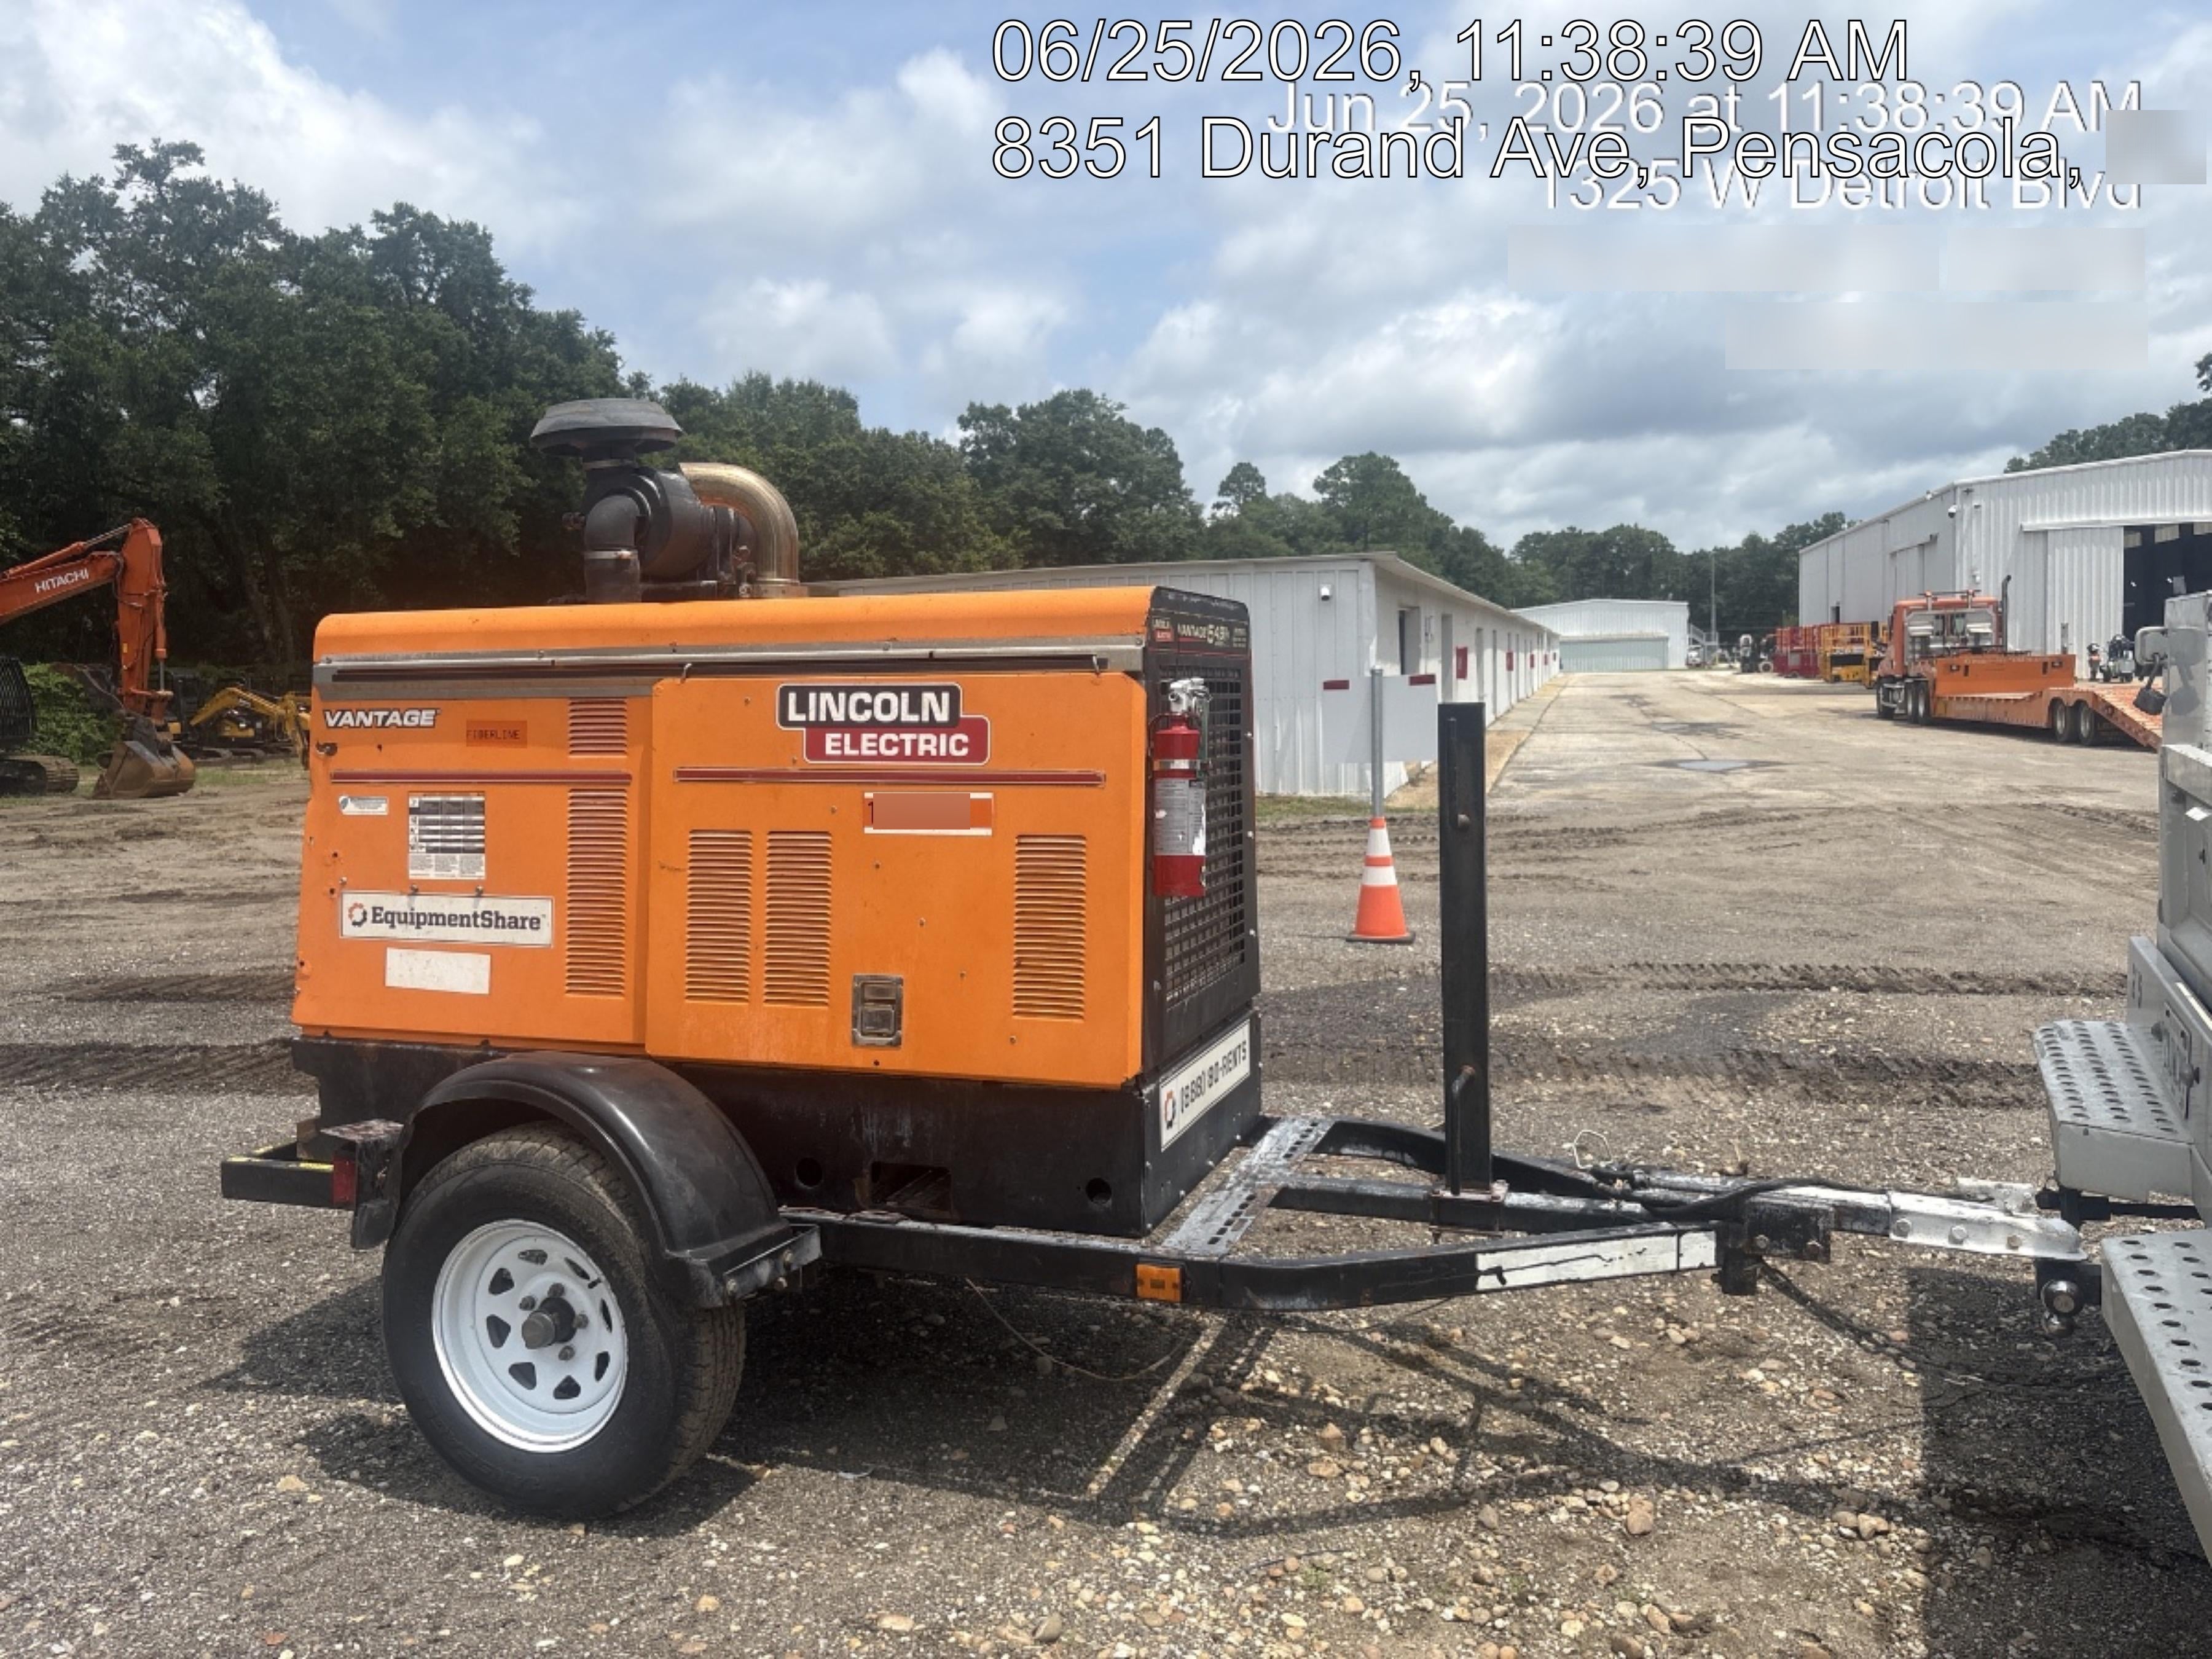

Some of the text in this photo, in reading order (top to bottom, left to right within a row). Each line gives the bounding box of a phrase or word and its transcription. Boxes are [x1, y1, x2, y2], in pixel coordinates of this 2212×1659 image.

[34, 568, 88, 594] HITACHI
[323, 708, 437, 728] VANTAGE
[788, 692, 950, 722] LINCOLN
[825, 733, 969, 756] ELECTRIC
